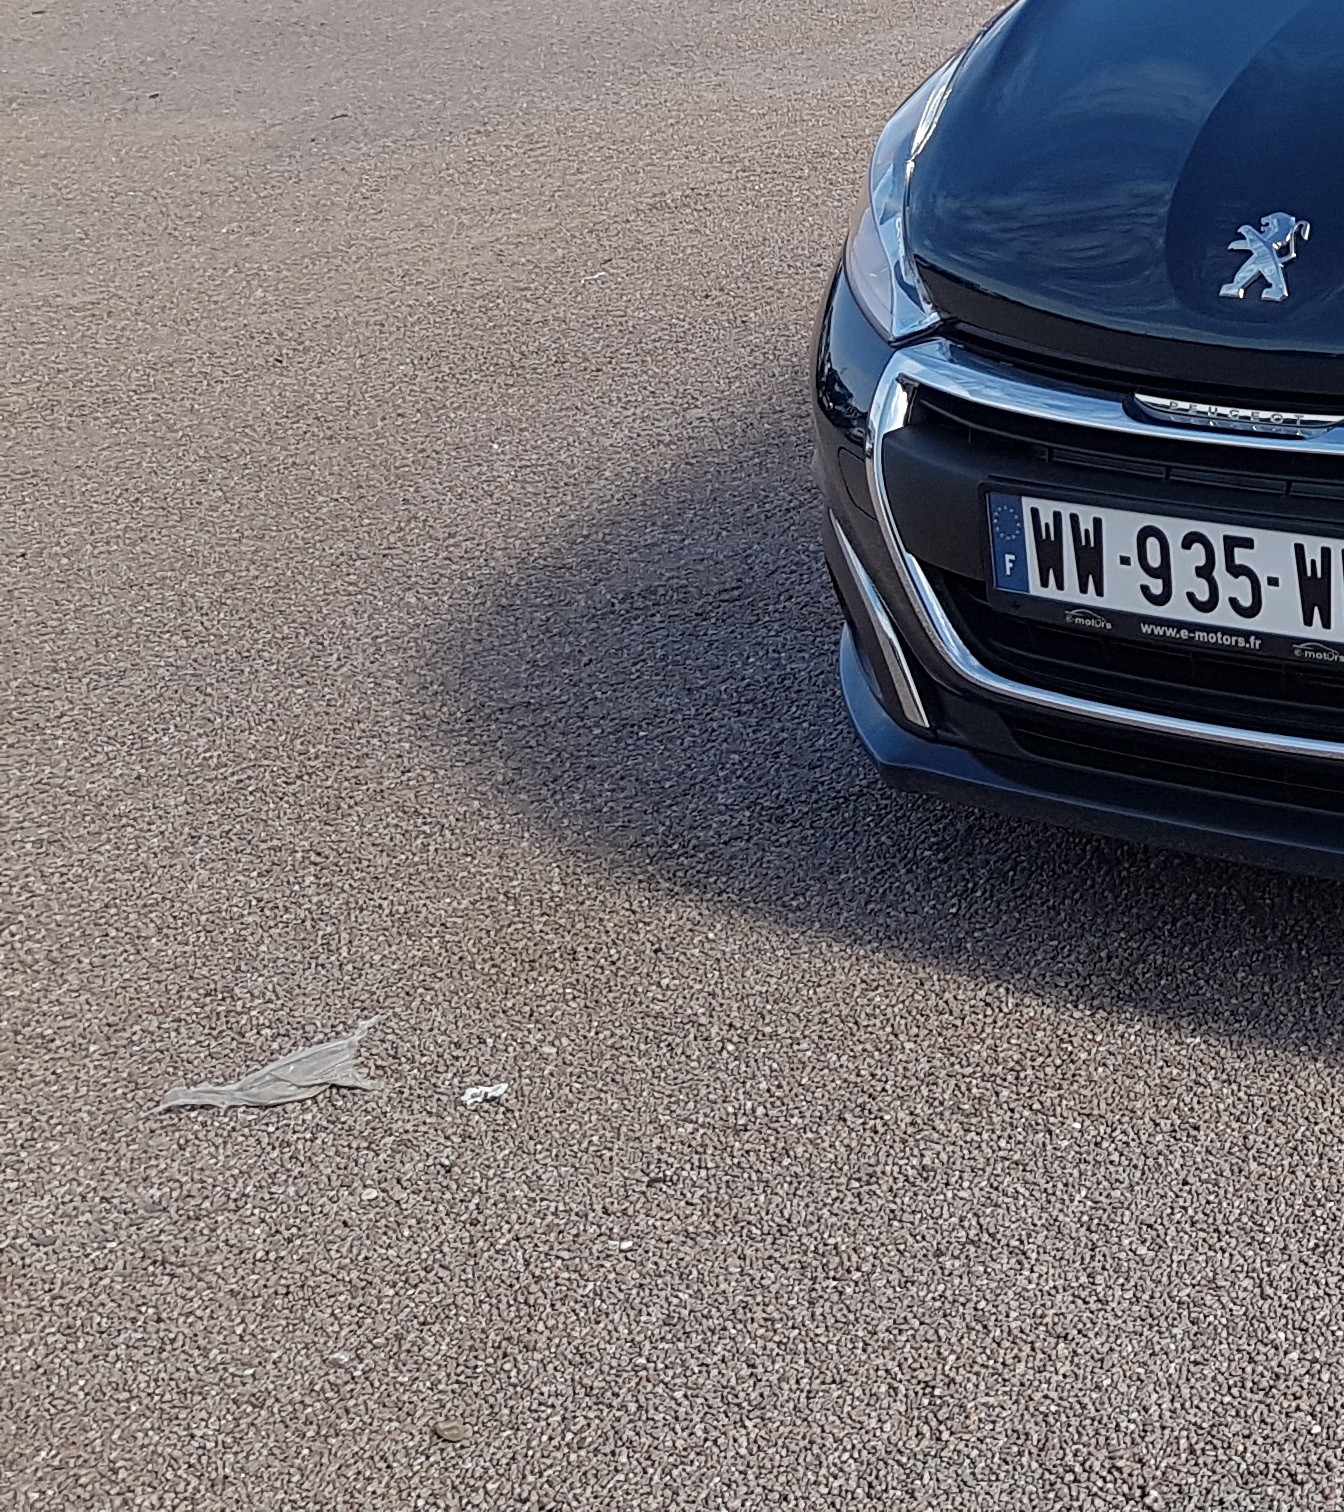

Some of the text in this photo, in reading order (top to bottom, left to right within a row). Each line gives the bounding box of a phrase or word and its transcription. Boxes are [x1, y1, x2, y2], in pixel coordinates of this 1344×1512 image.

[1169, 400, 1305, 426] PEUGEOT
[1004, 554, 1017, 577] F
[1140, 622, 1263, 650] www.e-motors.fr
